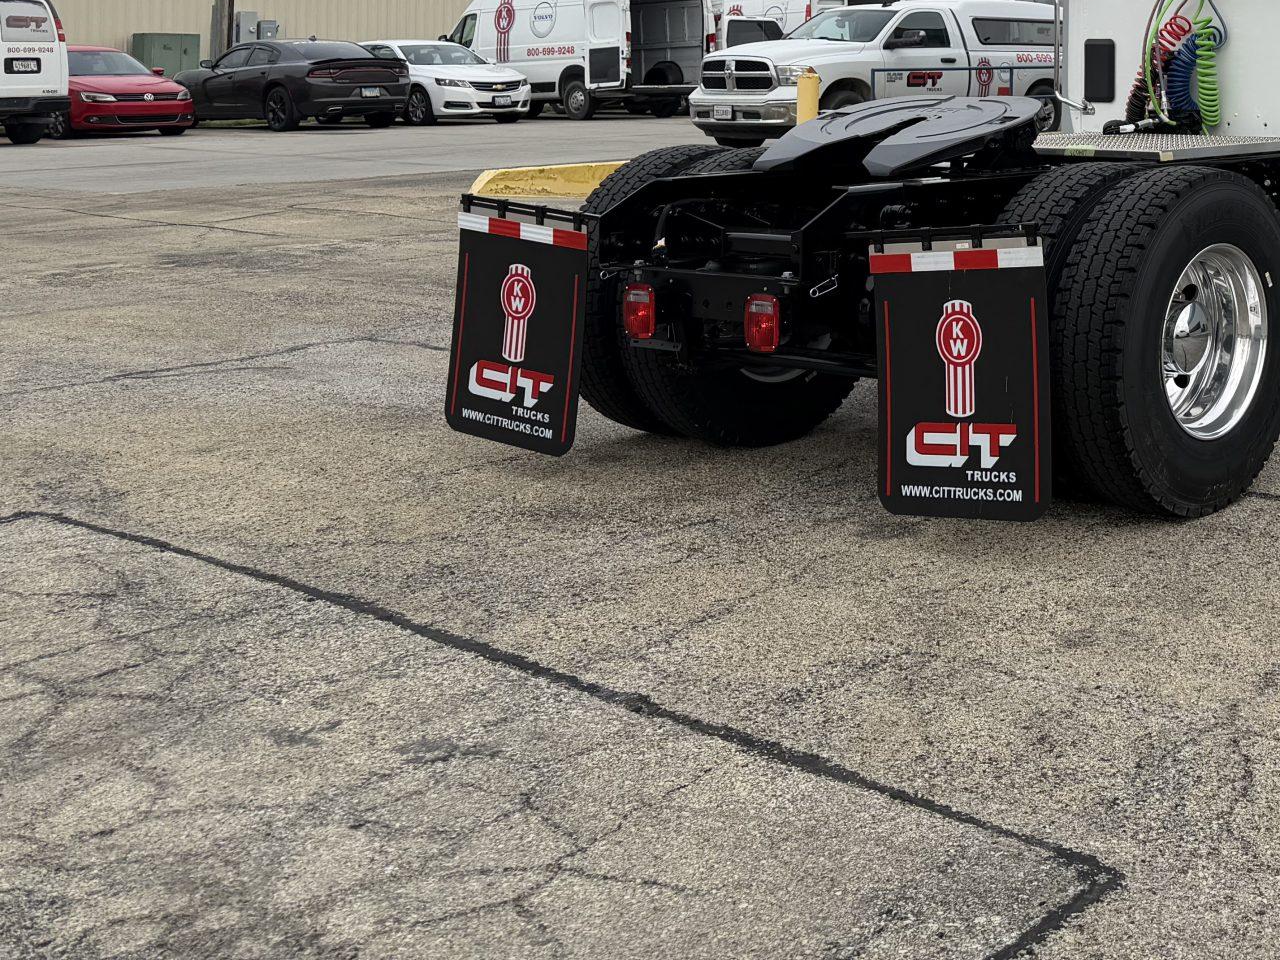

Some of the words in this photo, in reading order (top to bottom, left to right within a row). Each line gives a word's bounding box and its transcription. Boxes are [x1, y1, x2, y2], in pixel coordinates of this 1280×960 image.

[7, 46, 54, 54] 800-699-9248
[526, 45, 575, 57] 800-699-9248
[1016, 53, 1056, 63] 800-699-
[906, 71, 944, 88] CIT
[468, 359, 555, 408] CIT
[511, 405, 550, 423] TRUCKS
[461, 407, 553, 440] WWW.CITTRUCKS.COM
[906, 421, 1018, 469] CIT
[965, 470, 1017, 483] TRUCKS
[900, 484, 1023, 502] WWW.CITTRUCKS.COM
